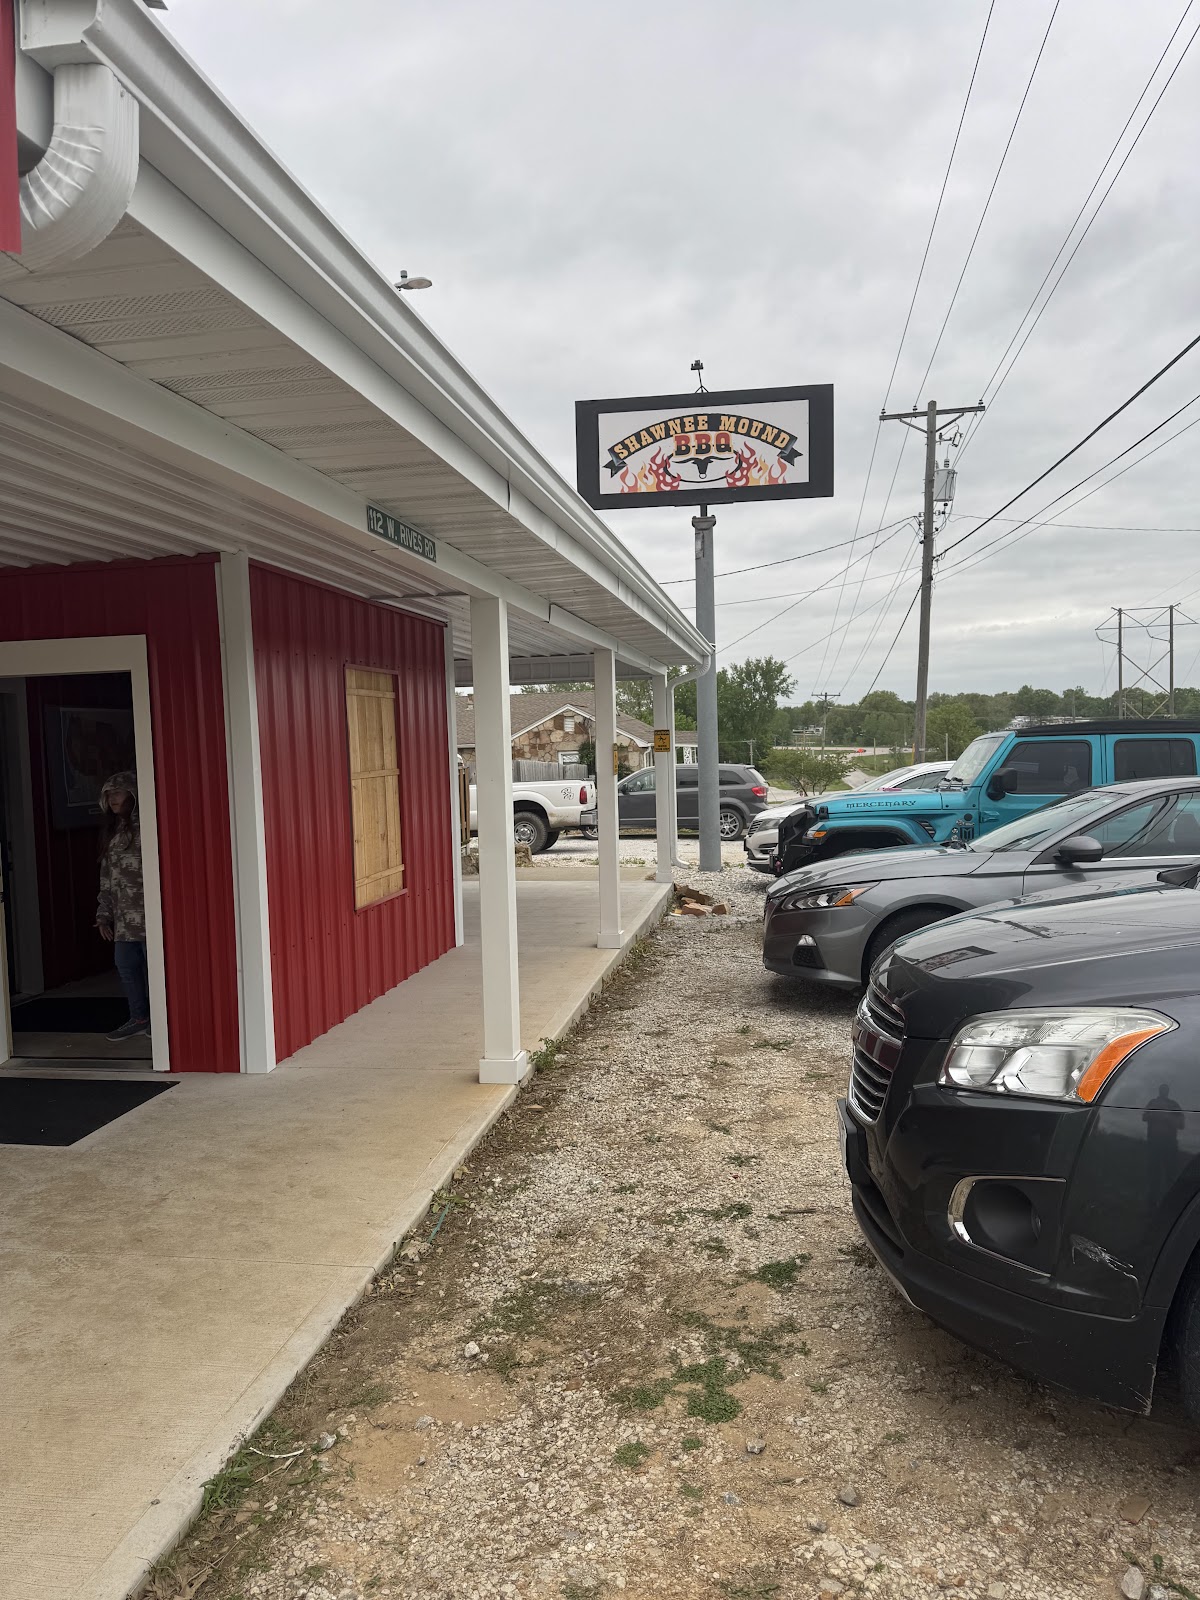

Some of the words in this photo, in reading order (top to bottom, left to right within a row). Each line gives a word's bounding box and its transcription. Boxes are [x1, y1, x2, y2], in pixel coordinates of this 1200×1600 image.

[613, 415, 708, 459] SHAWNEE
[719, 415, 790, 448] MOUND
[673, 430, 734, 457] BBQ
[369, 508, 384, 534] 112
[386, 517, 398, 541] W.
[400, 524, 423, 553] RIVES
[846, 800, 917, 810] MERCENARY
